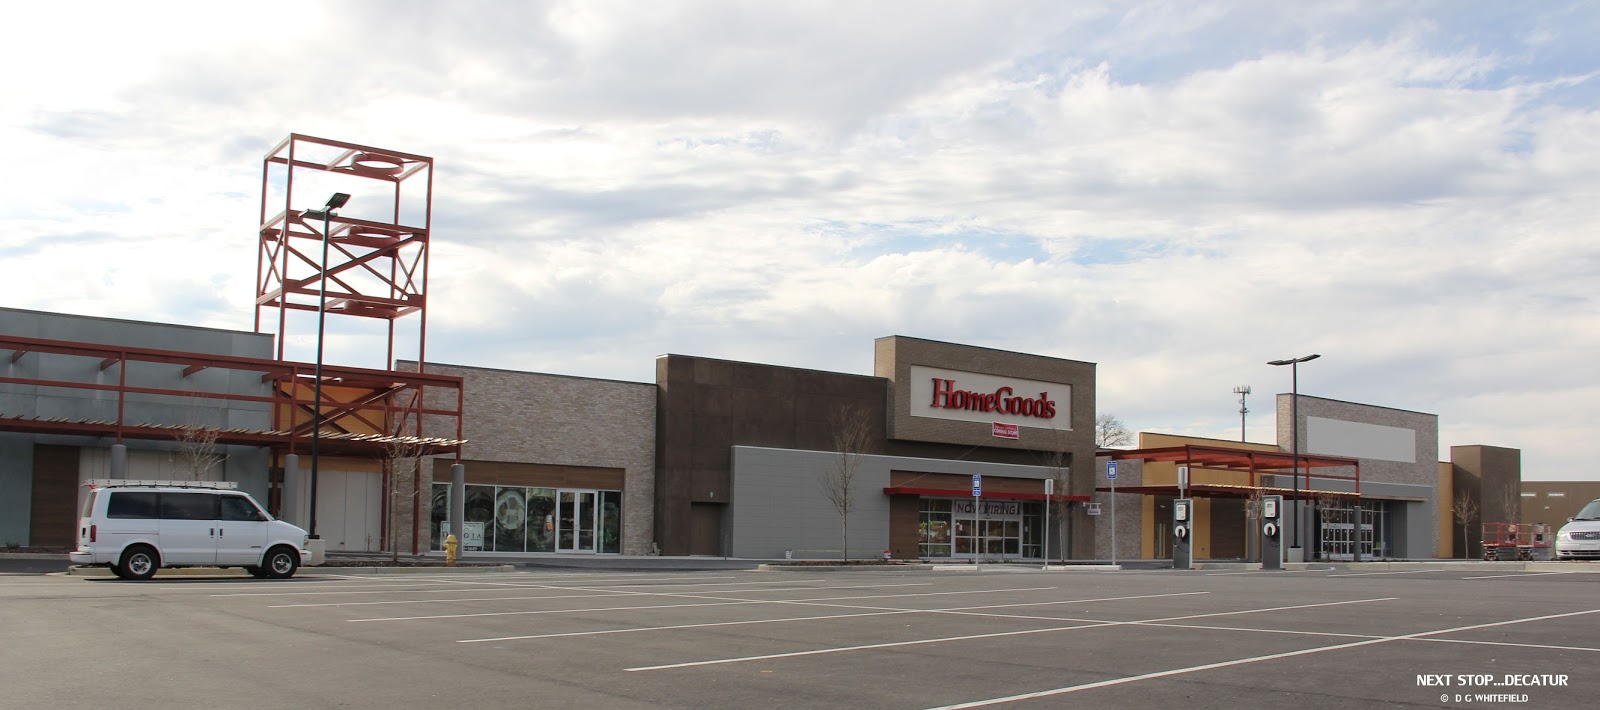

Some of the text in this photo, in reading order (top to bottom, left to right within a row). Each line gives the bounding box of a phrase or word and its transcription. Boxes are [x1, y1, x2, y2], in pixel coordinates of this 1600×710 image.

[930, 377, 1056, 419] HomeGoods
[957, 503, 1016, 515] NOW HIRING
